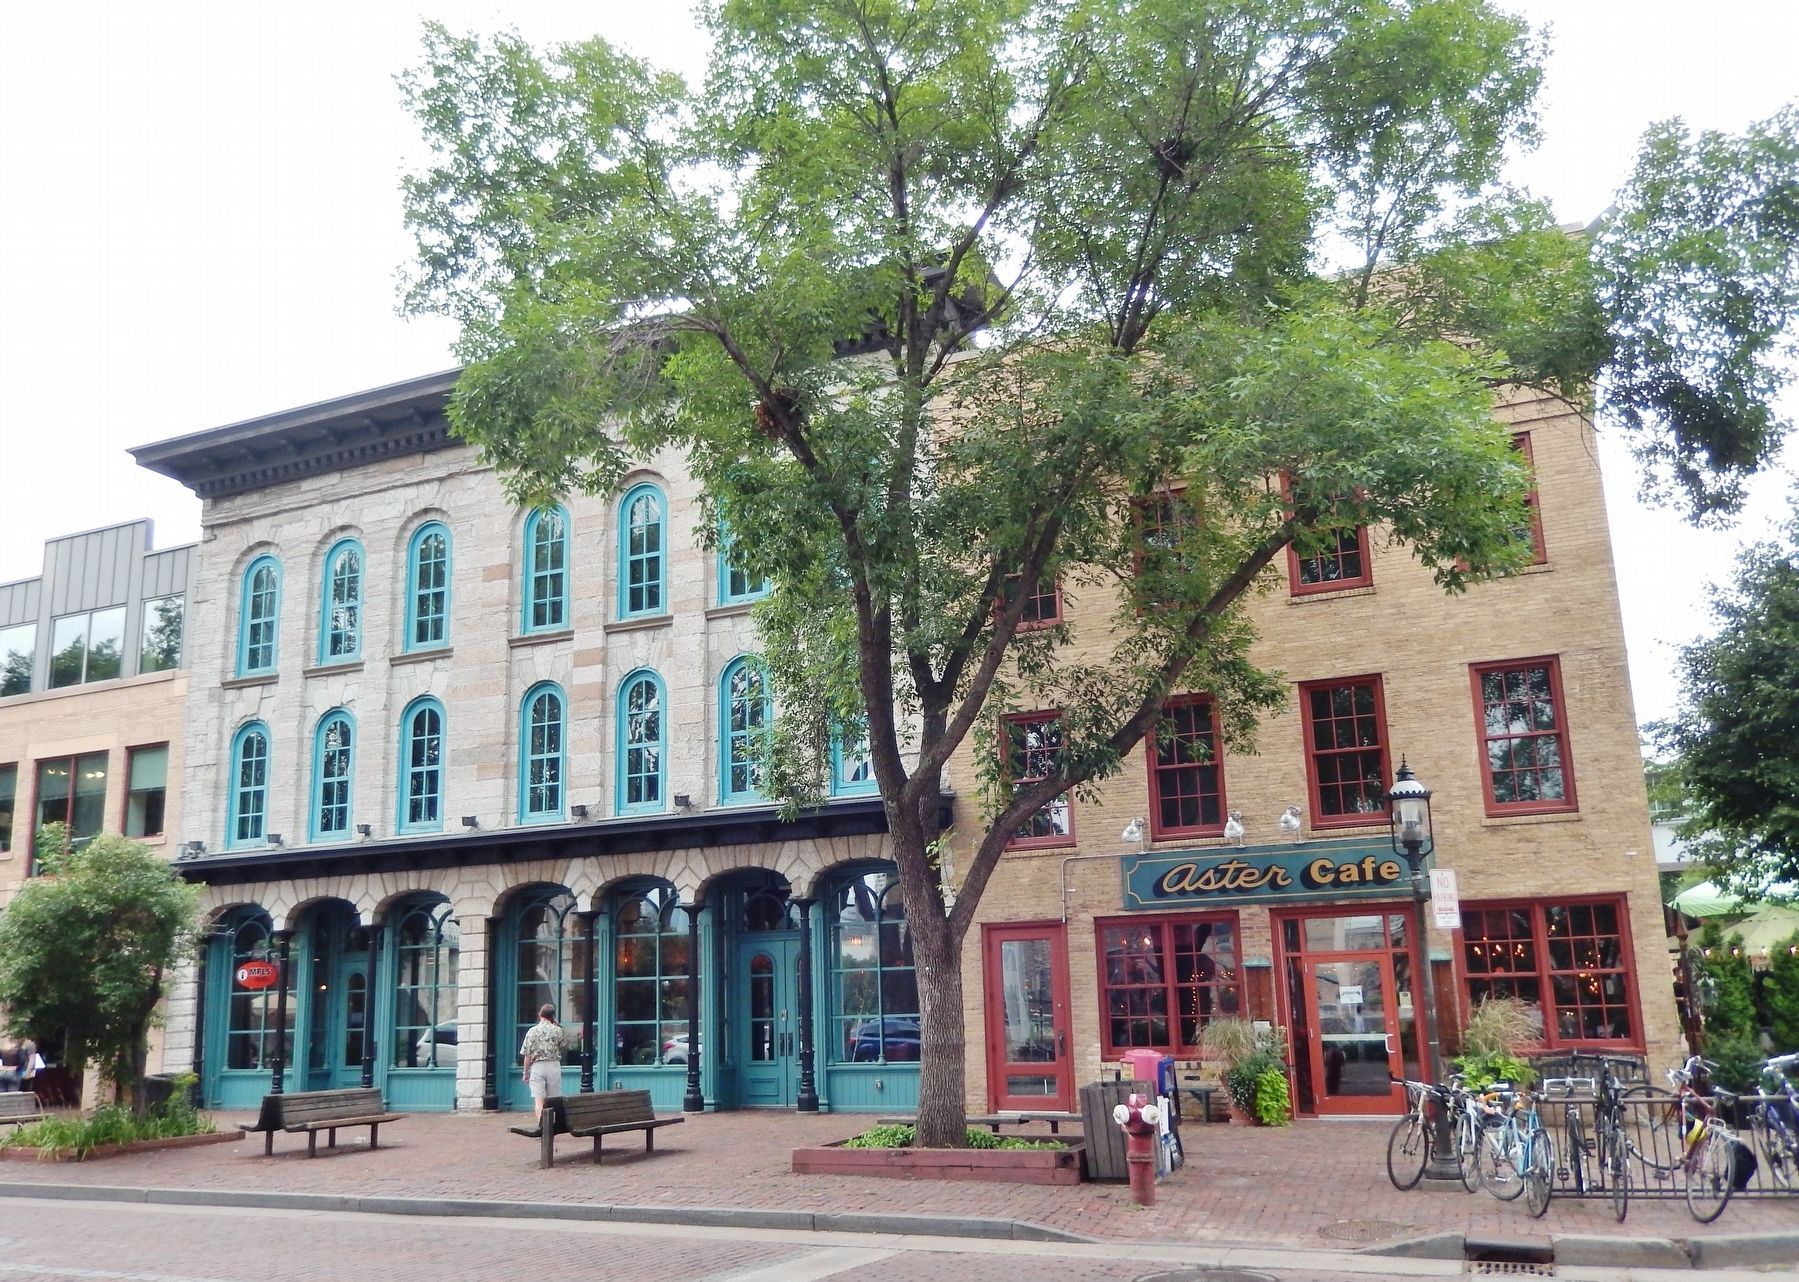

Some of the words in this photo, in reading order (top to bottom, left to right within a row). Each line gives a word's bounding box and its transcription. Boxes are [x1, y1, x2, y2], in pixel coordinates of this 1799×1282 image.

[1309, 856, 1400, 884] Cafe
[1437, 876, 1449, 888] NO
[249, 968, 272, 976] MPLS
